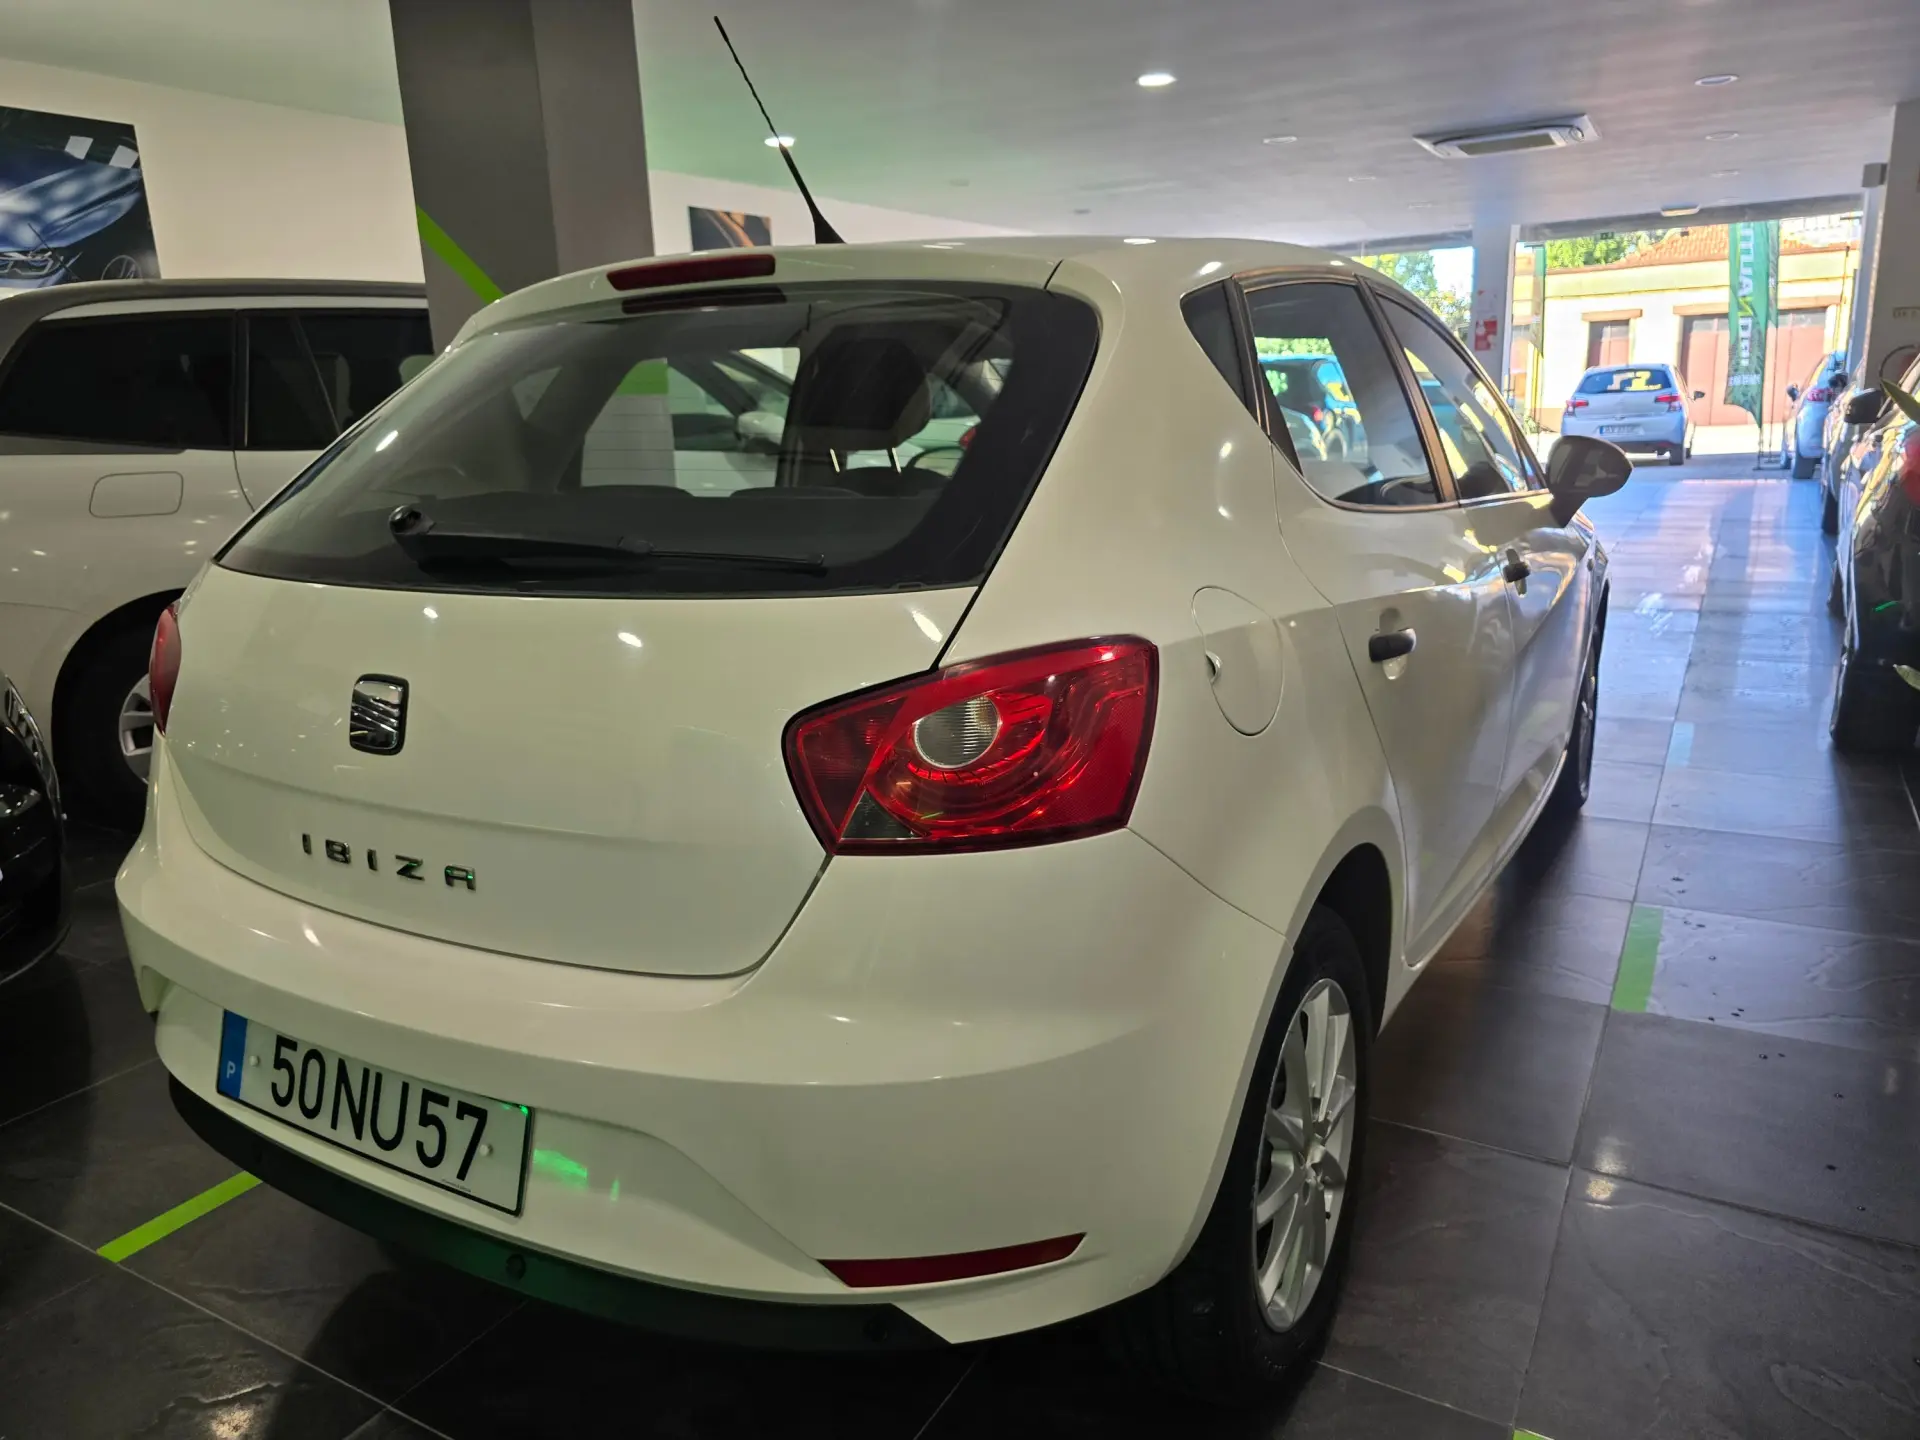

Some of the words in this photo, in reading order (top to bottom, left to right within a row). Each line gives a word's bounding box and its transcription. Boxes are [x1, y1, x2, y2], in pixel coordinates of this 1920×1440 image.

[302, 833, 476, 891] IBIZA
[226, 1060, 236, 1079] P
[271, 1034, 488, 1181] 50NU57
